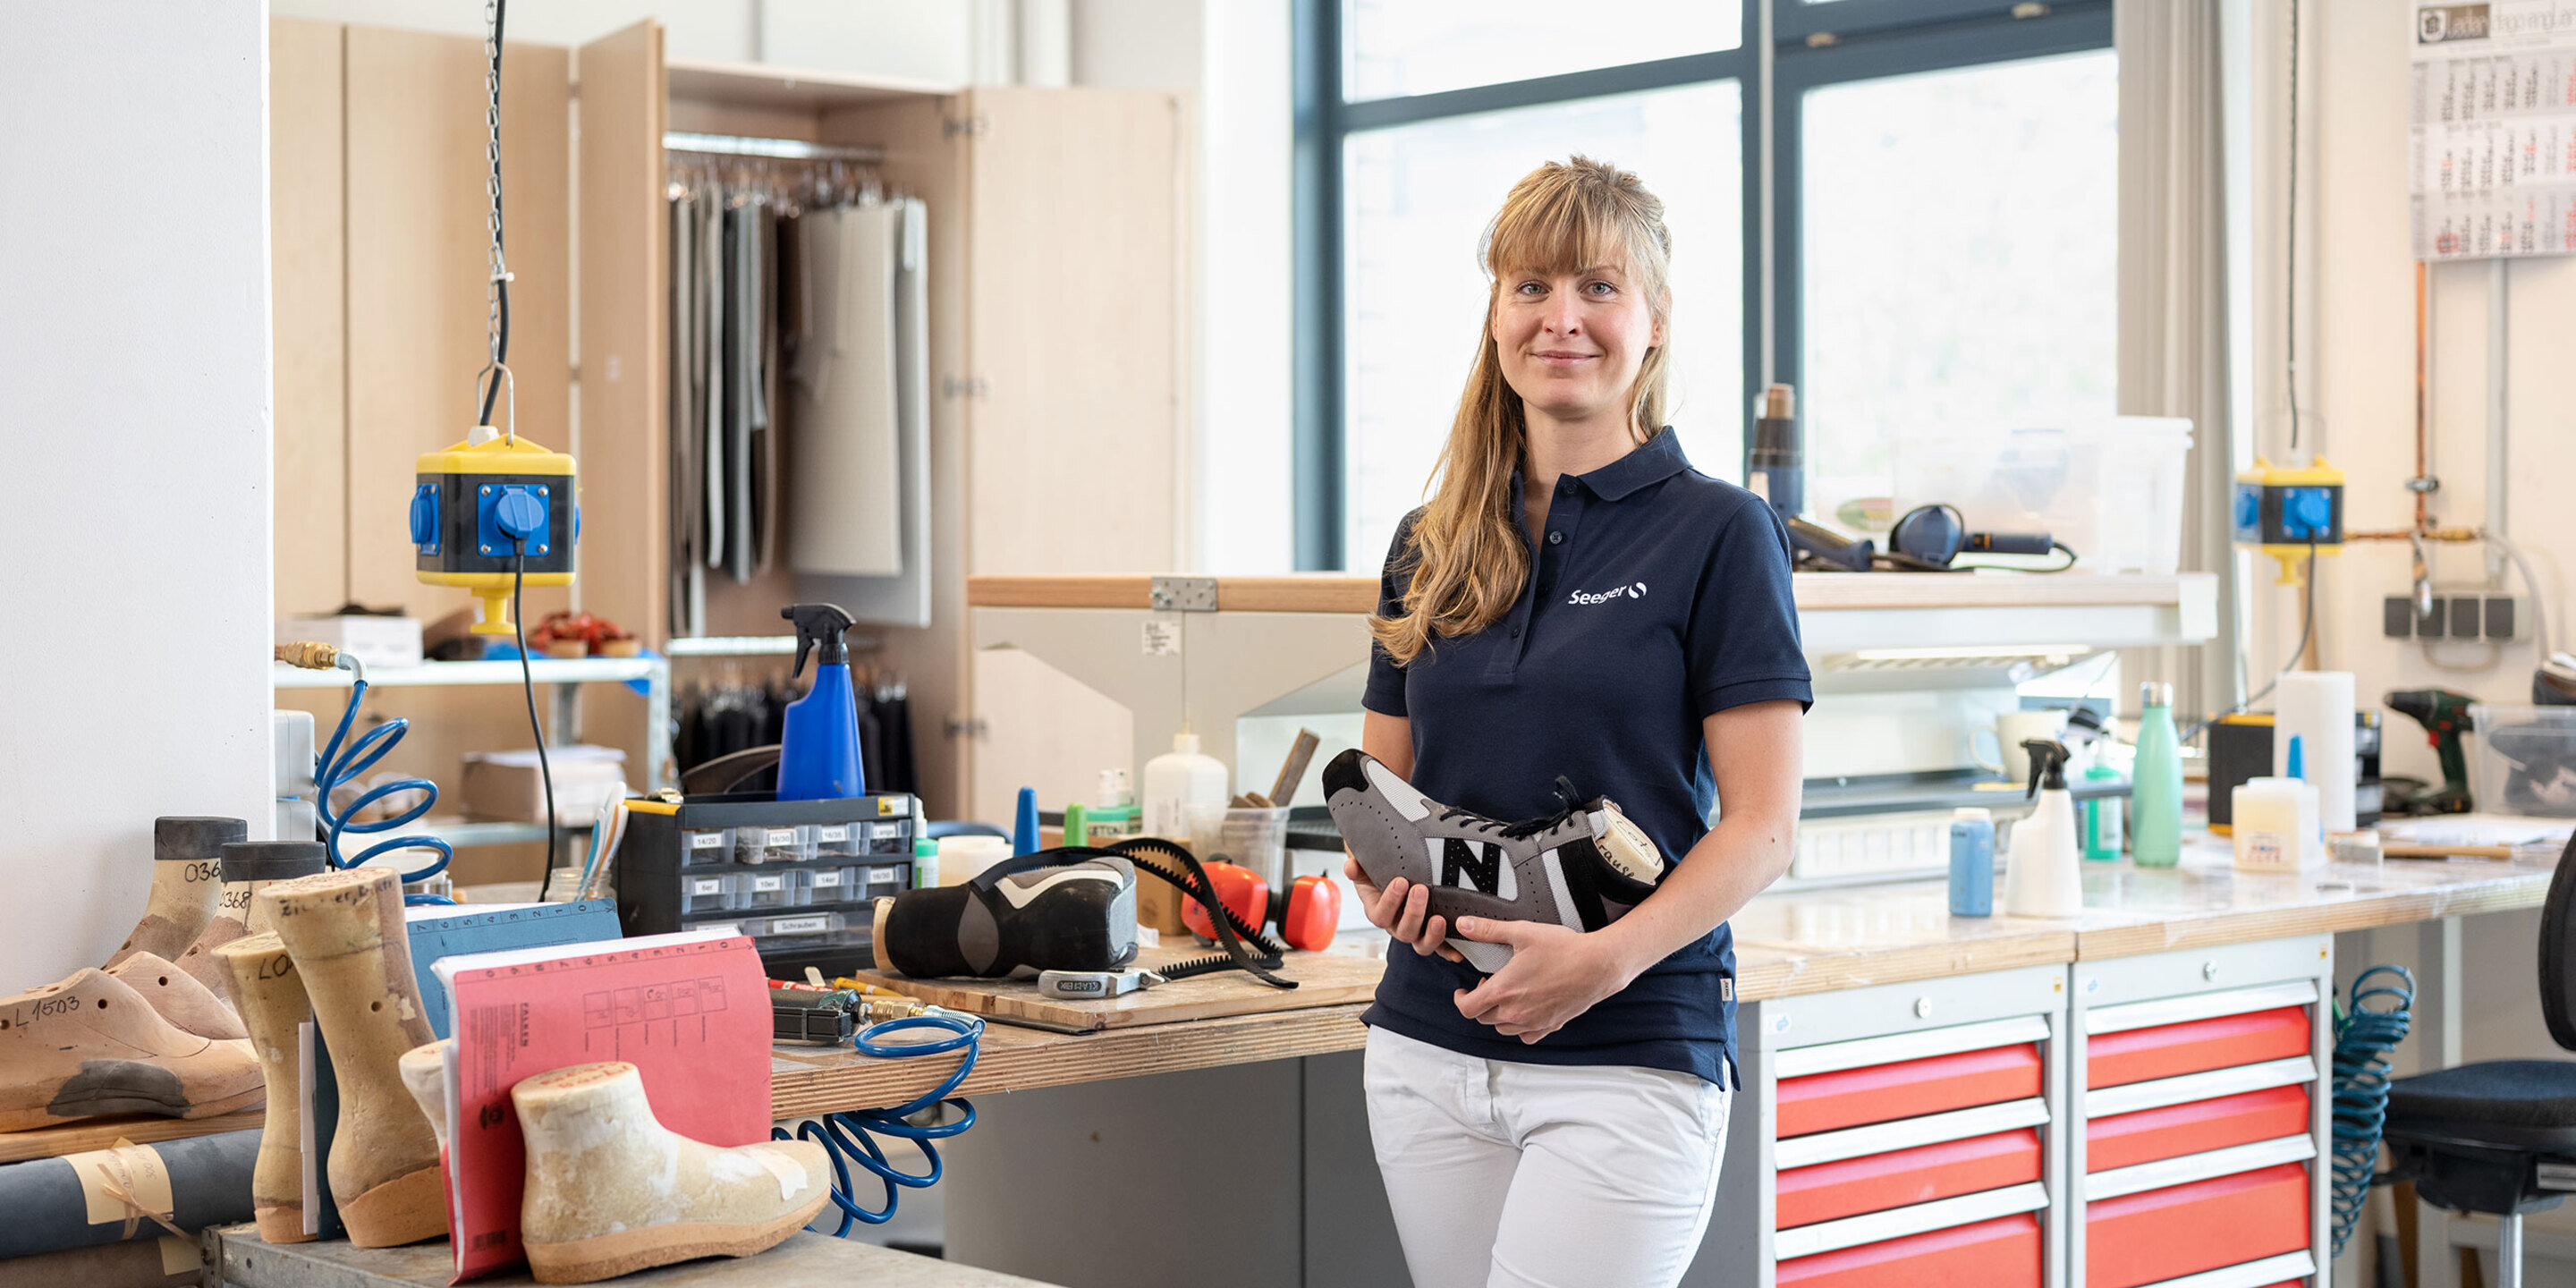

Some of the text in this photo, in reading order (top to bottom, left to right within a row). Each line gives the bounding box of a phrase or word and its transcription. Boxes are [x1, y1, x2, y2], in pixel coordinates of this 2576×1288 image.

[1568, 585, 1627, 605] Seeger
[698, 837, 716, 845] 14/20
[781, 921, 817, 930] Schrauben
